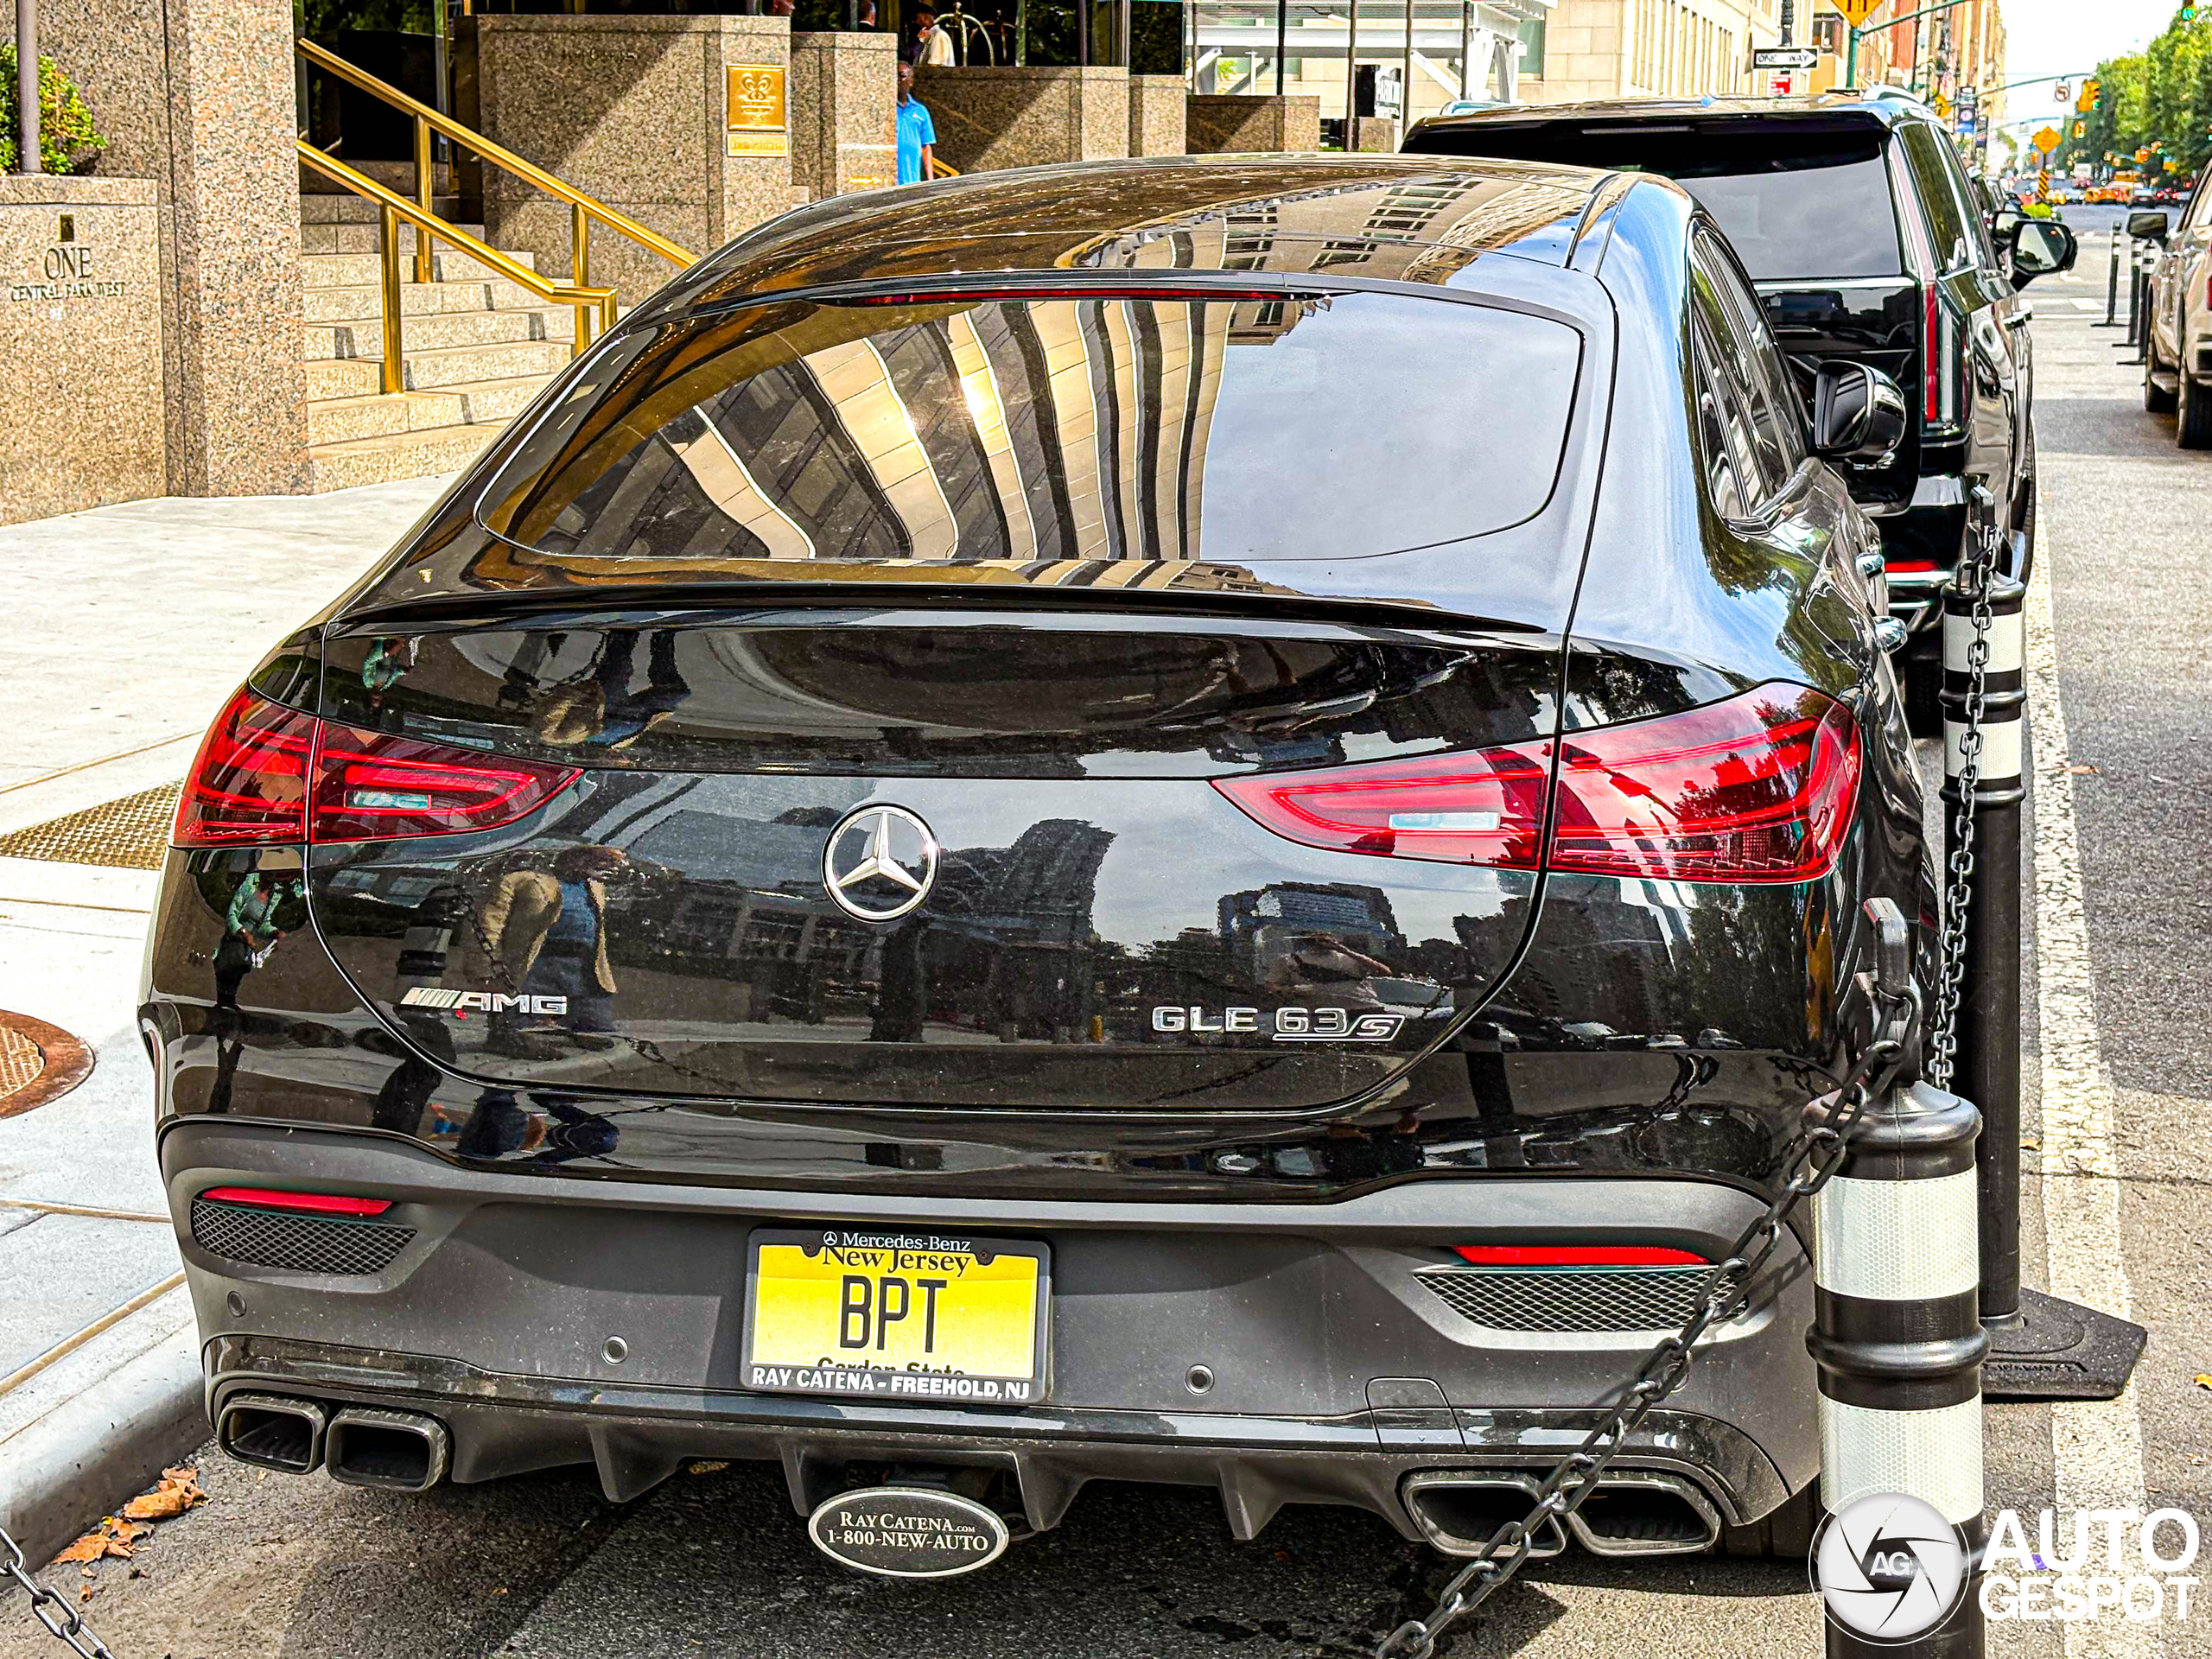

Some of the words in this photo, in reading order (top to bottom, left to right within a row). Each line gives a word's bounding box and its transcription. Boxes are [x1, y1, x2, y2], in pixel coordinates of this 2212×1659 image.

[1758, 54, 1777, 63] ONE
[1788, 54, 1809, 63] WAY
[44, 247, 93, 280] ONE
[10, 285, 63, 302] CENTRAL
[66, 283, 93, 298] PARK
[96, 282, 126, 297] WEST
[452, 991, 568, 1014] AMG
[1152, 1006, 1259, 1033] GLE
[842, 1232, 971, 1252] Mercedes-Benz
[823, 1247, 885, 1268] New
[887, 1249, 971, 1277] Jersey
[839, 1274, 948, 1354] BPT
[752, 1367, 796, 1387] RAY
[827, 1529, 989, 1552] 1-800-NEW-AUTO
